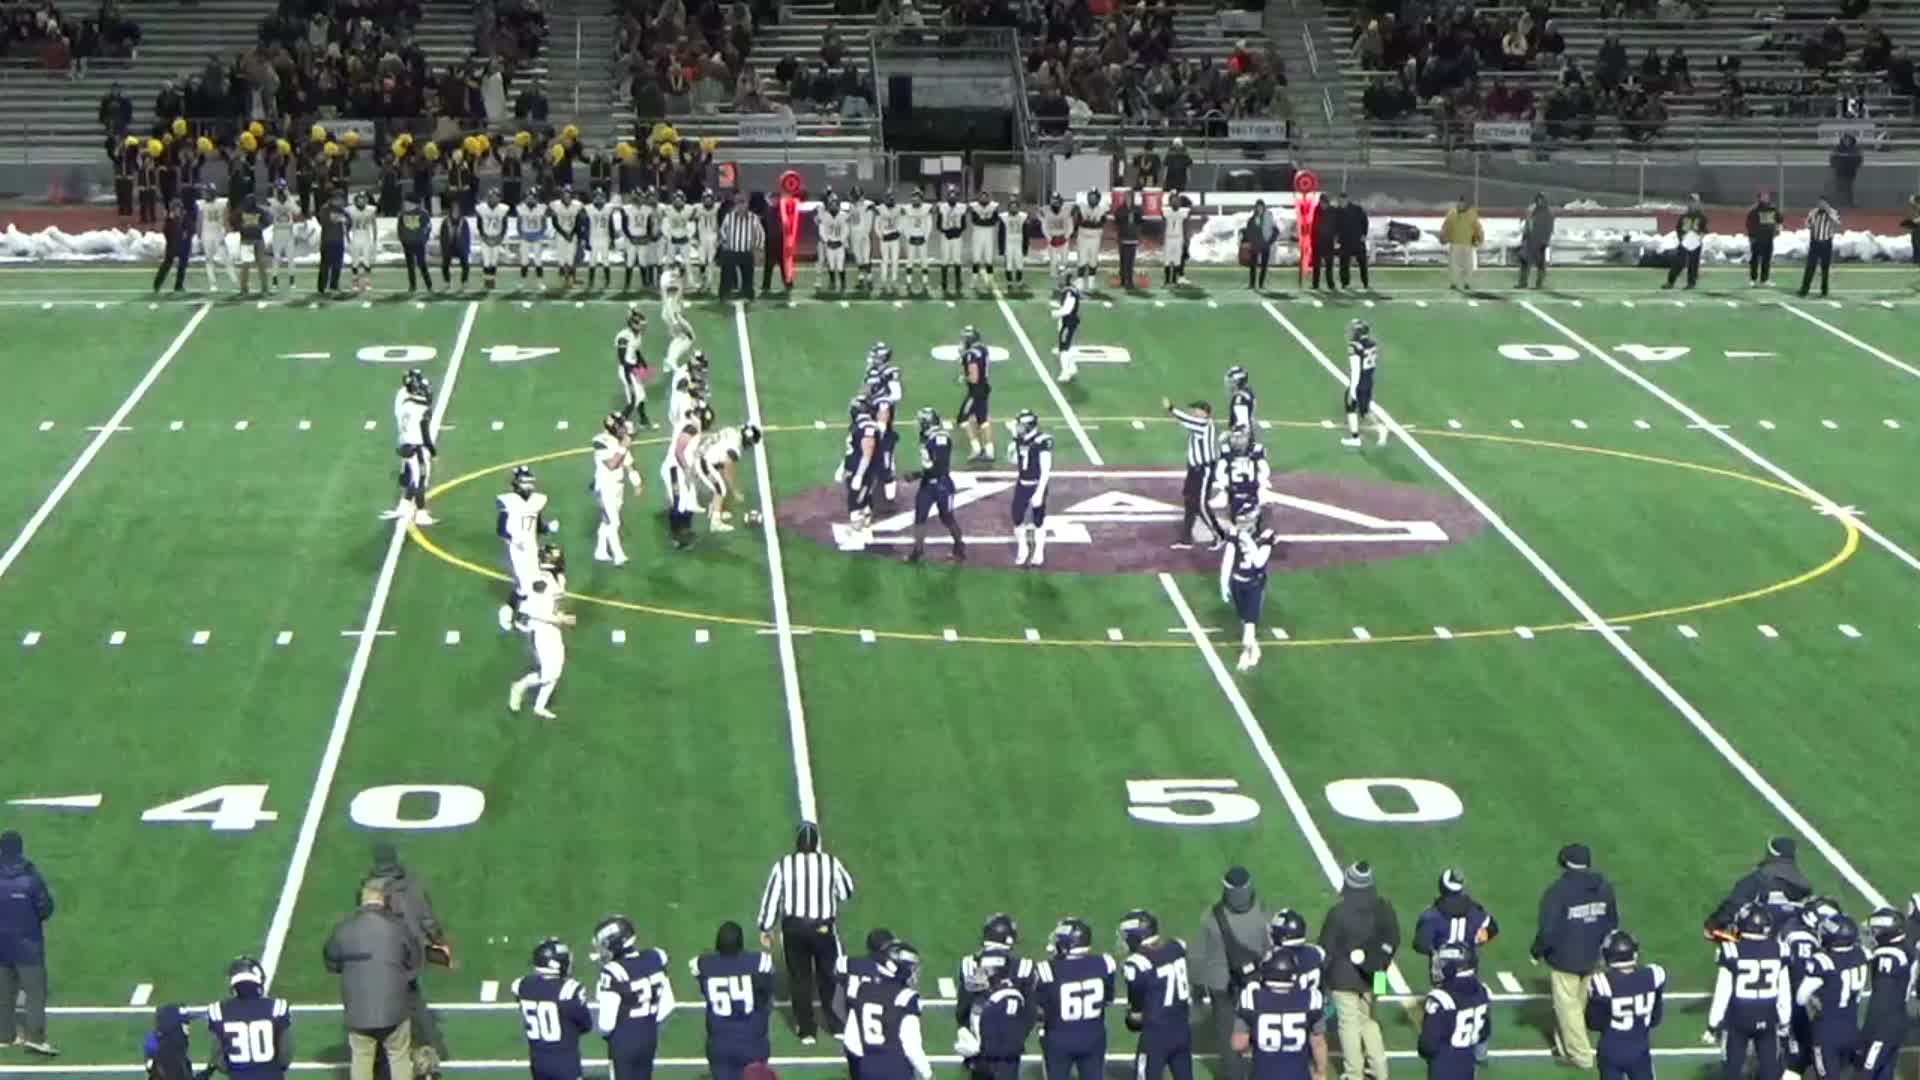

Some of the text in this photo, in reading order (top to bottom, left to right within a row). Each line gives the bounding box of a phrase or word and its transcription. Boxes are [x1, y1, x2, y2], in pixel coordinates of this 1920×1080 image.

[1231, 456, 1255, 483] 24
[707, 974, 754, 1017] 64
[1060, 978, 1105, 1022] 62
[1735, 959, 1781, 1000] 23
[519, 999, 561, 1042] 50
[1611, 991, 1656, 1031] 54
[223, 1019, 275, 1063] 30
[1257, 1012, 1307, 1053] 65
